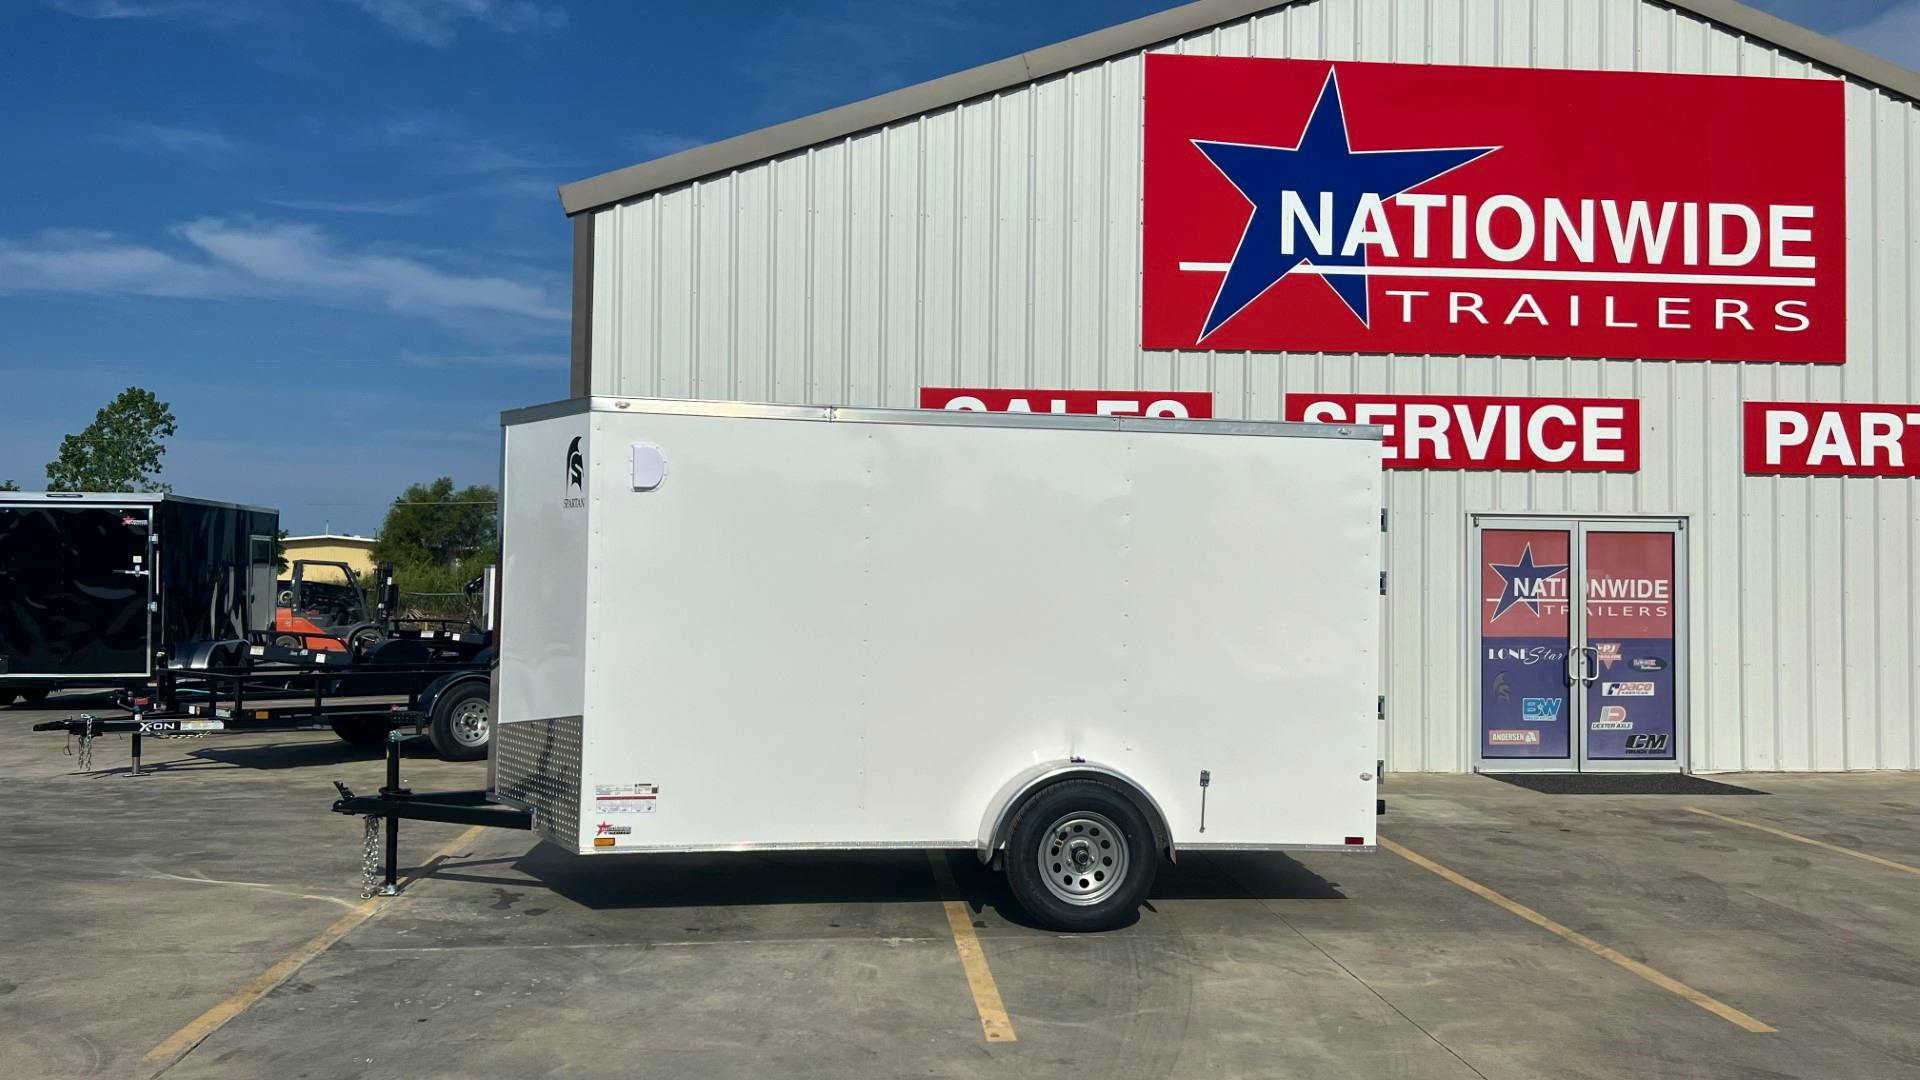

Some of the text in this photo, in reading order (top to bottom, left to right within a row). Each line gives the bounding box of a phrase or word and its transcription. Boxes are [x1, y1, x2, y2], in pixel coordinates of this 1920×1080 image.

[1280, 190, 1816, 270] NATIONWIDE
[1385, 290, 1811, 332] TRAILERS
[1765, 410, 1920, 467] PAR
[563, 498, 585, 508] SPARTAN
[1513, 577, 1669, 599] NATINWIDE
